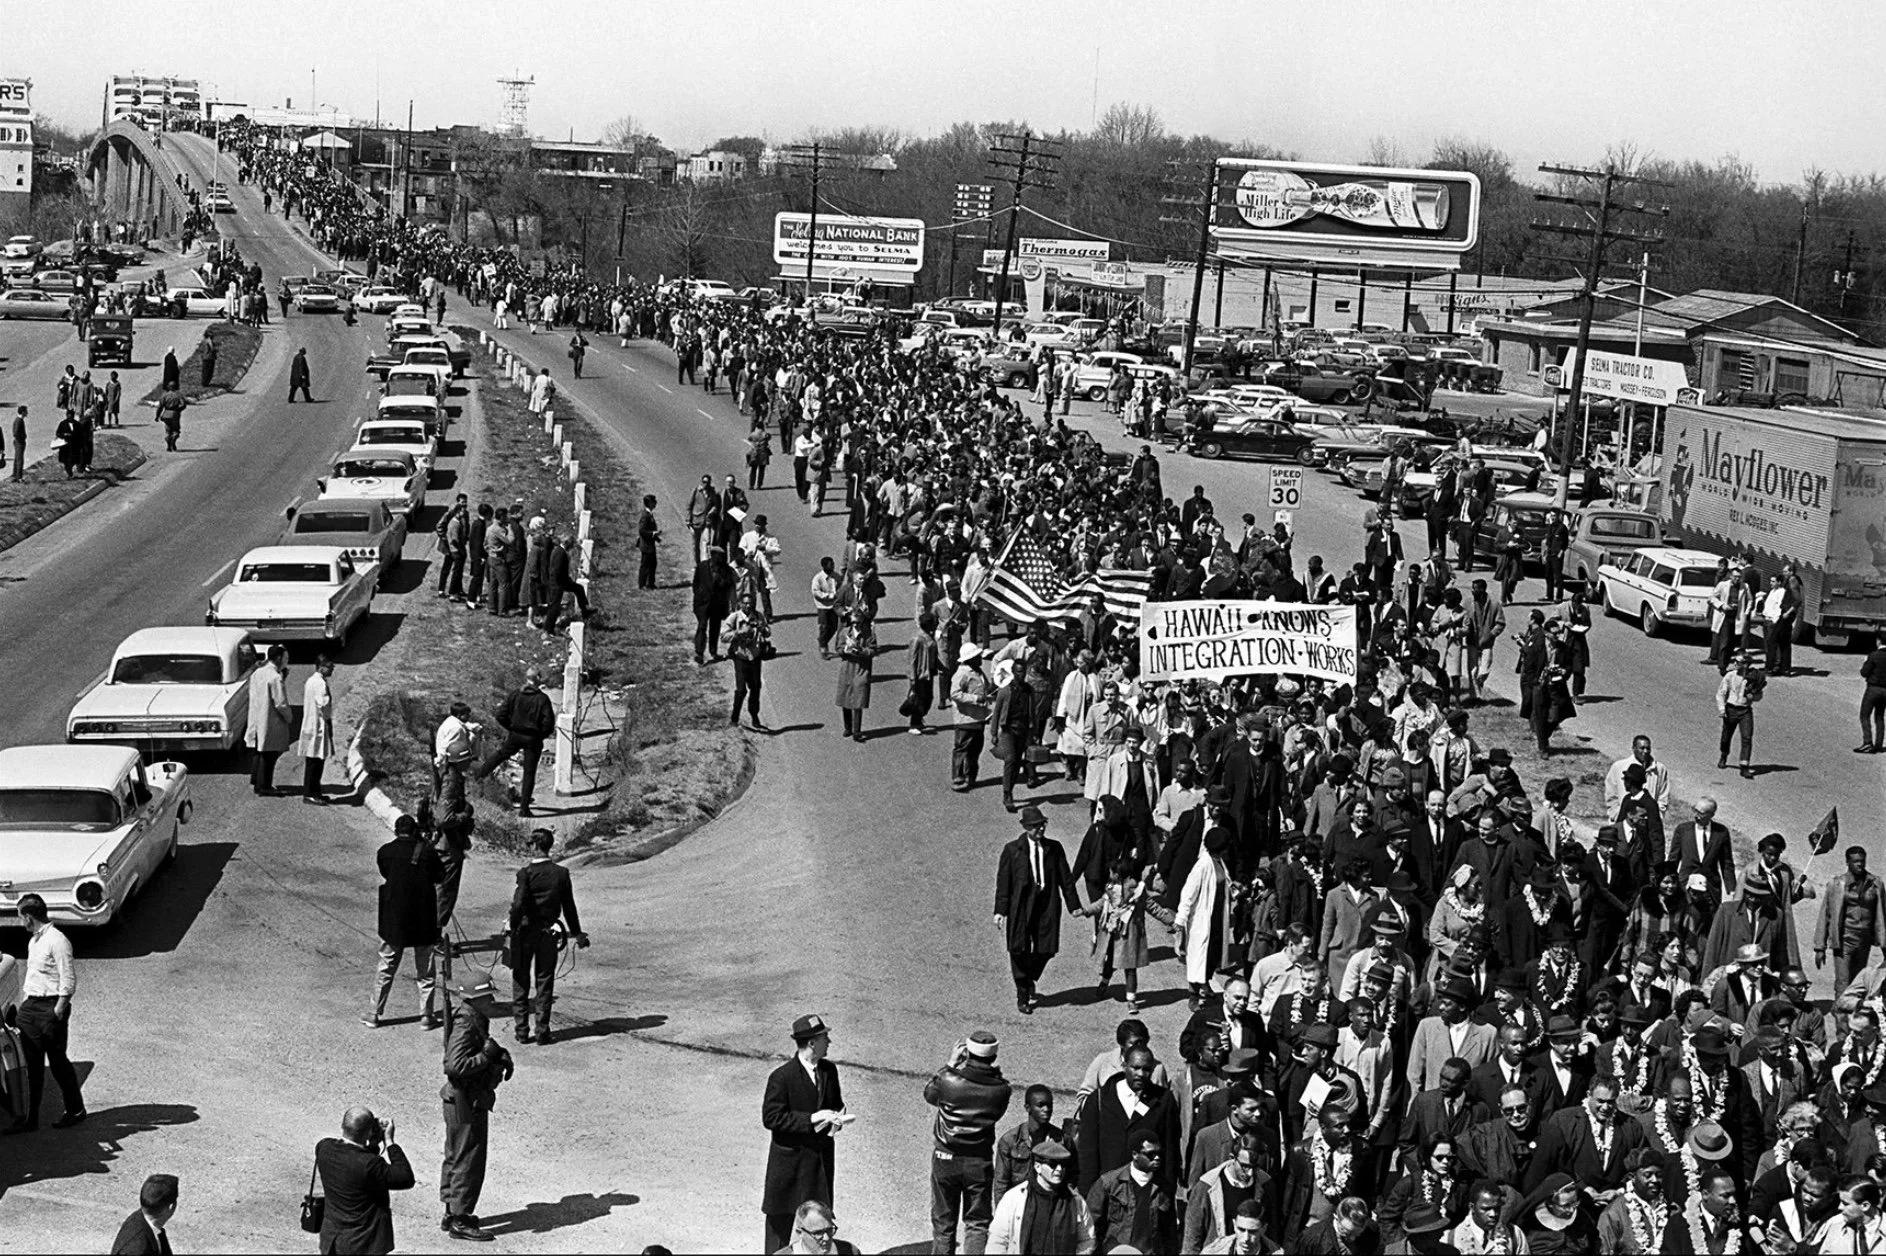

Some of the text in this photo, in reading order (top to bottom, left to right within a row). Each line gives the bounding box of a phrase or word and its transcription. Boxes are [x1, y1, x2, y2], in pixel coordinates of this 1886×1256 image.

[1246, 193, 1279, 207] Miller
[1244, 206, 1296, 220] High Life
[826, 225, 884, 240] NATIONAL
[886, 228, 918, 243] BANK
[786, 240, 833, 250] welcmes
[837, 244, 854, 253] you
[873, 245, 911, 254] SELMA
[1021, 242, 1108, 258] Thermogas
[1591, 357, 1655, 380] SELMA TRACTOR CO.
[1272, 469, 1302, 479] SPEED
[1699, 428, 1828, 509] Mayflower
[1275, 479, 1298, 488] LIMIT
[1271, 487, 1300, 505] 30
[1164, 608, 1243, 638] HAWAII
[1149, 637, 1356, 677] INTEGRATION WORKS
